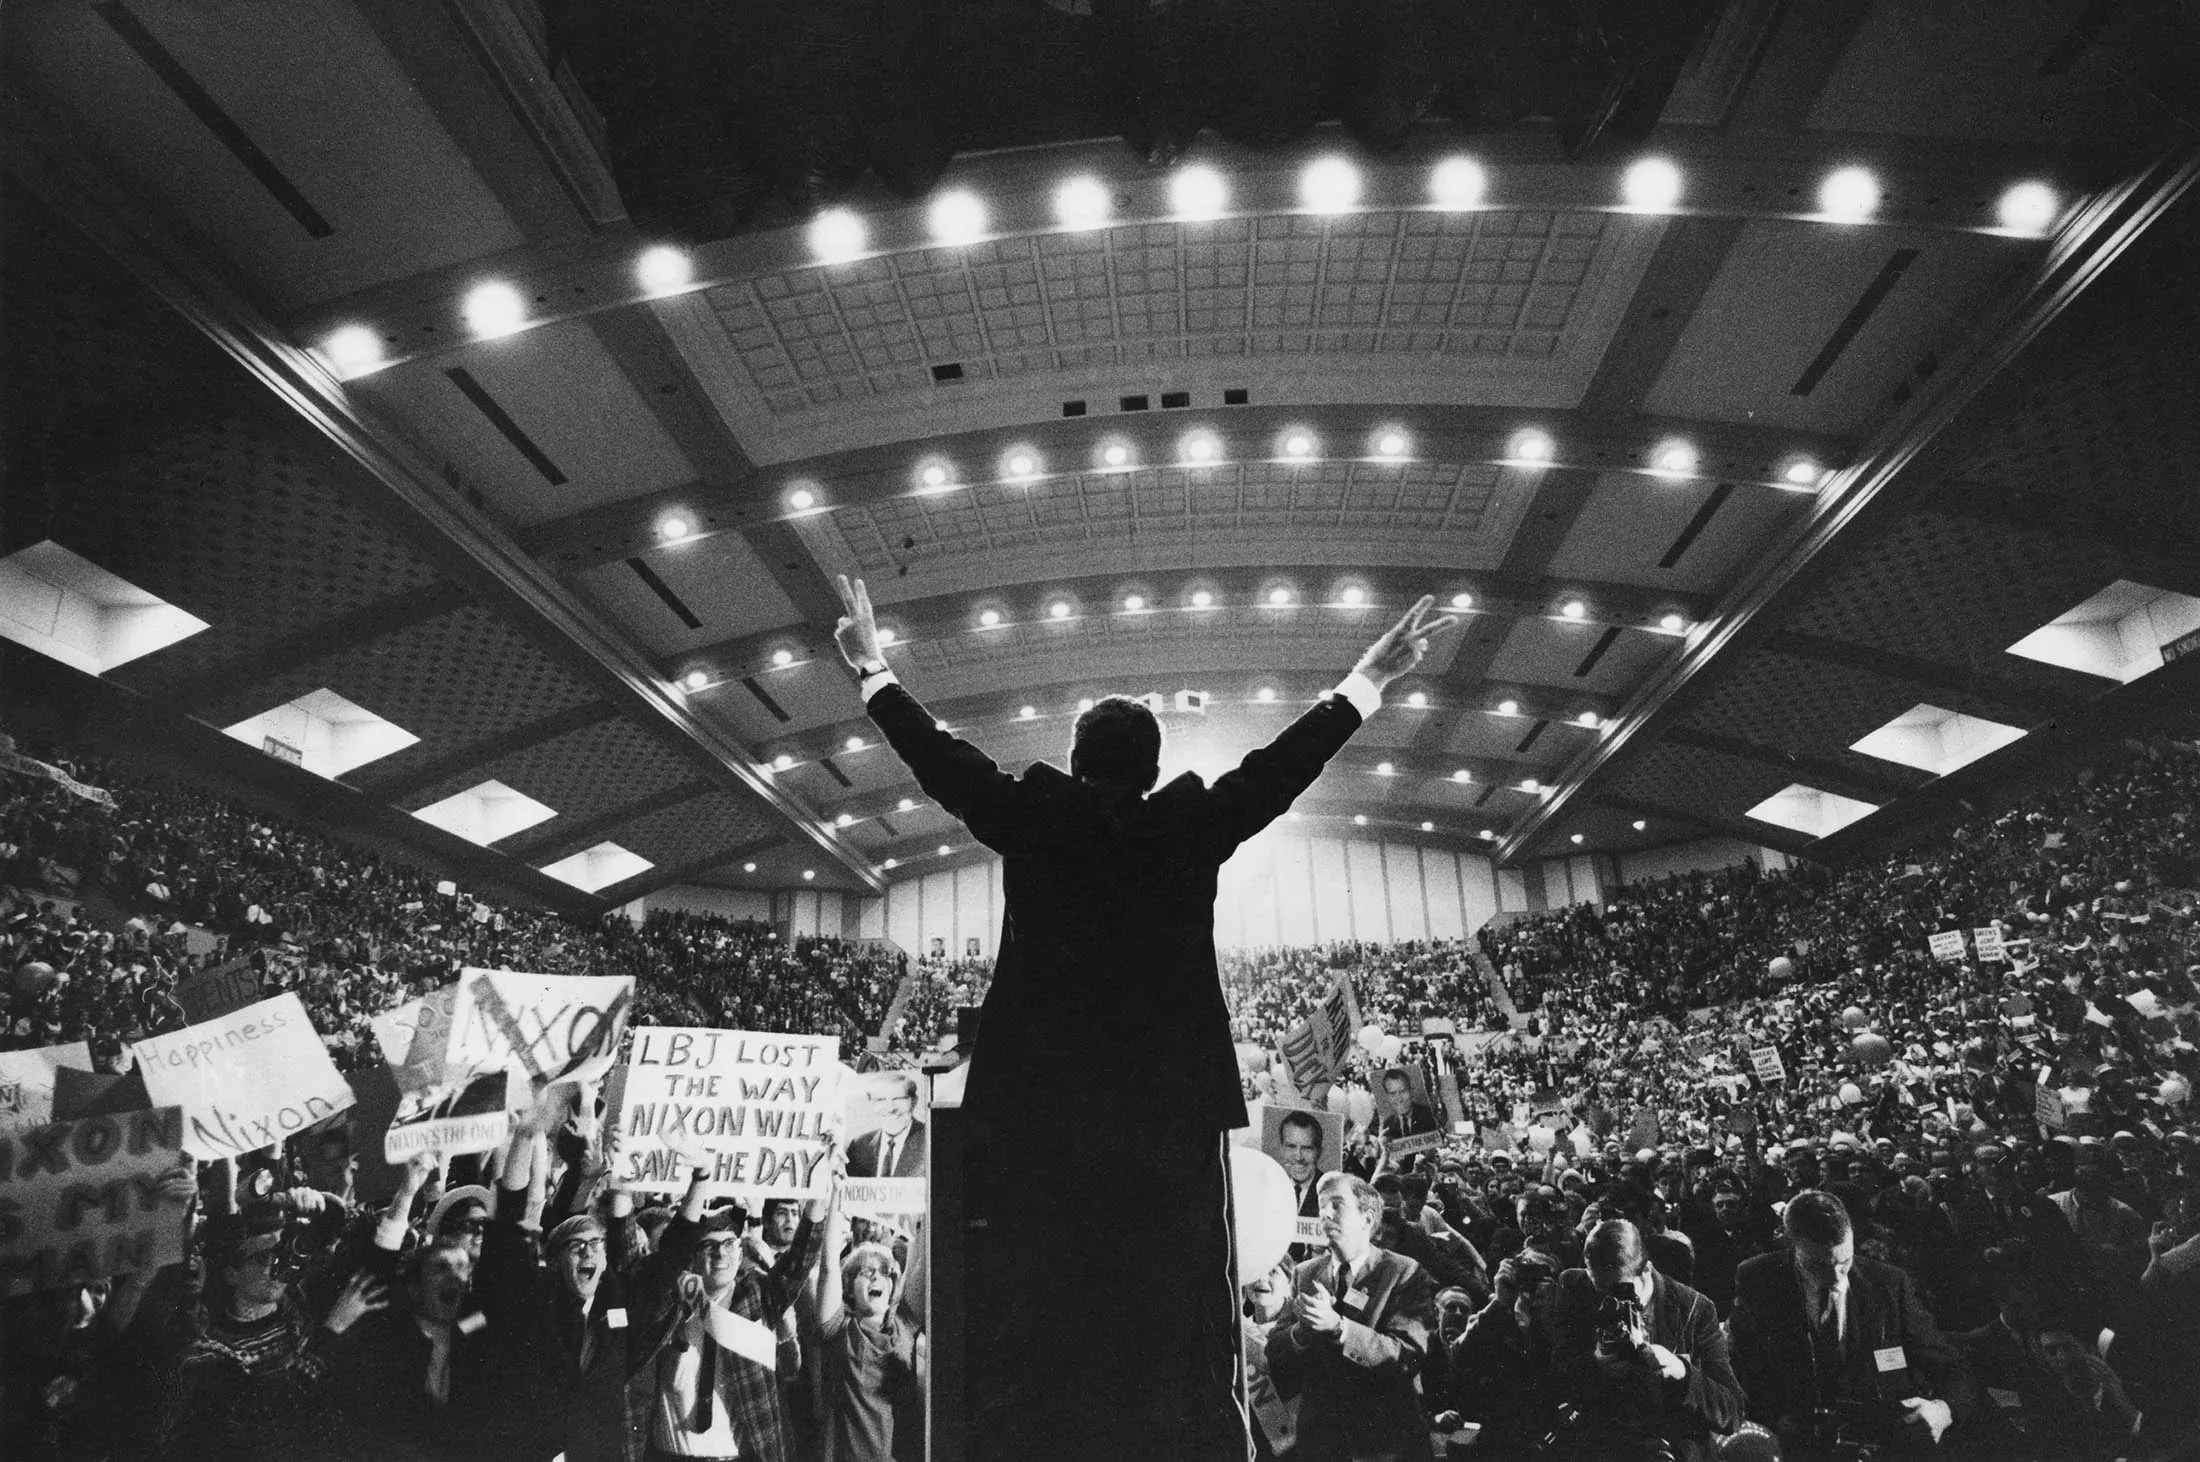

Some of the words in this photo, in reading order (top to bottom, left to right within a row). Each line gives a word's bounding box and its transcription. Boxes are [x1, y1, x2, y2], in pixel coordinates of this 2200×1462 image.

[138, 1011, 288, 1074] Happiness
[638, 1033, 723, 1069] LBJ
[736, 1040, 820, 1068] LOST
[665, 1074, 723, 1098] THE
[739, 1076, 820, 1103] WAY
[190, 1096, 335, 1157] Nixon
[628, 1103, 746, 1137] NIXON
[754, 1108, 828, 1140] WILL
[619, 1147, 682, 1183] SAVE
[753, 1146, 825, 1188] DAY
[844, 1184, 888, 1203] NIXON'S
[1296, 1221, 1314, 1236] THE
